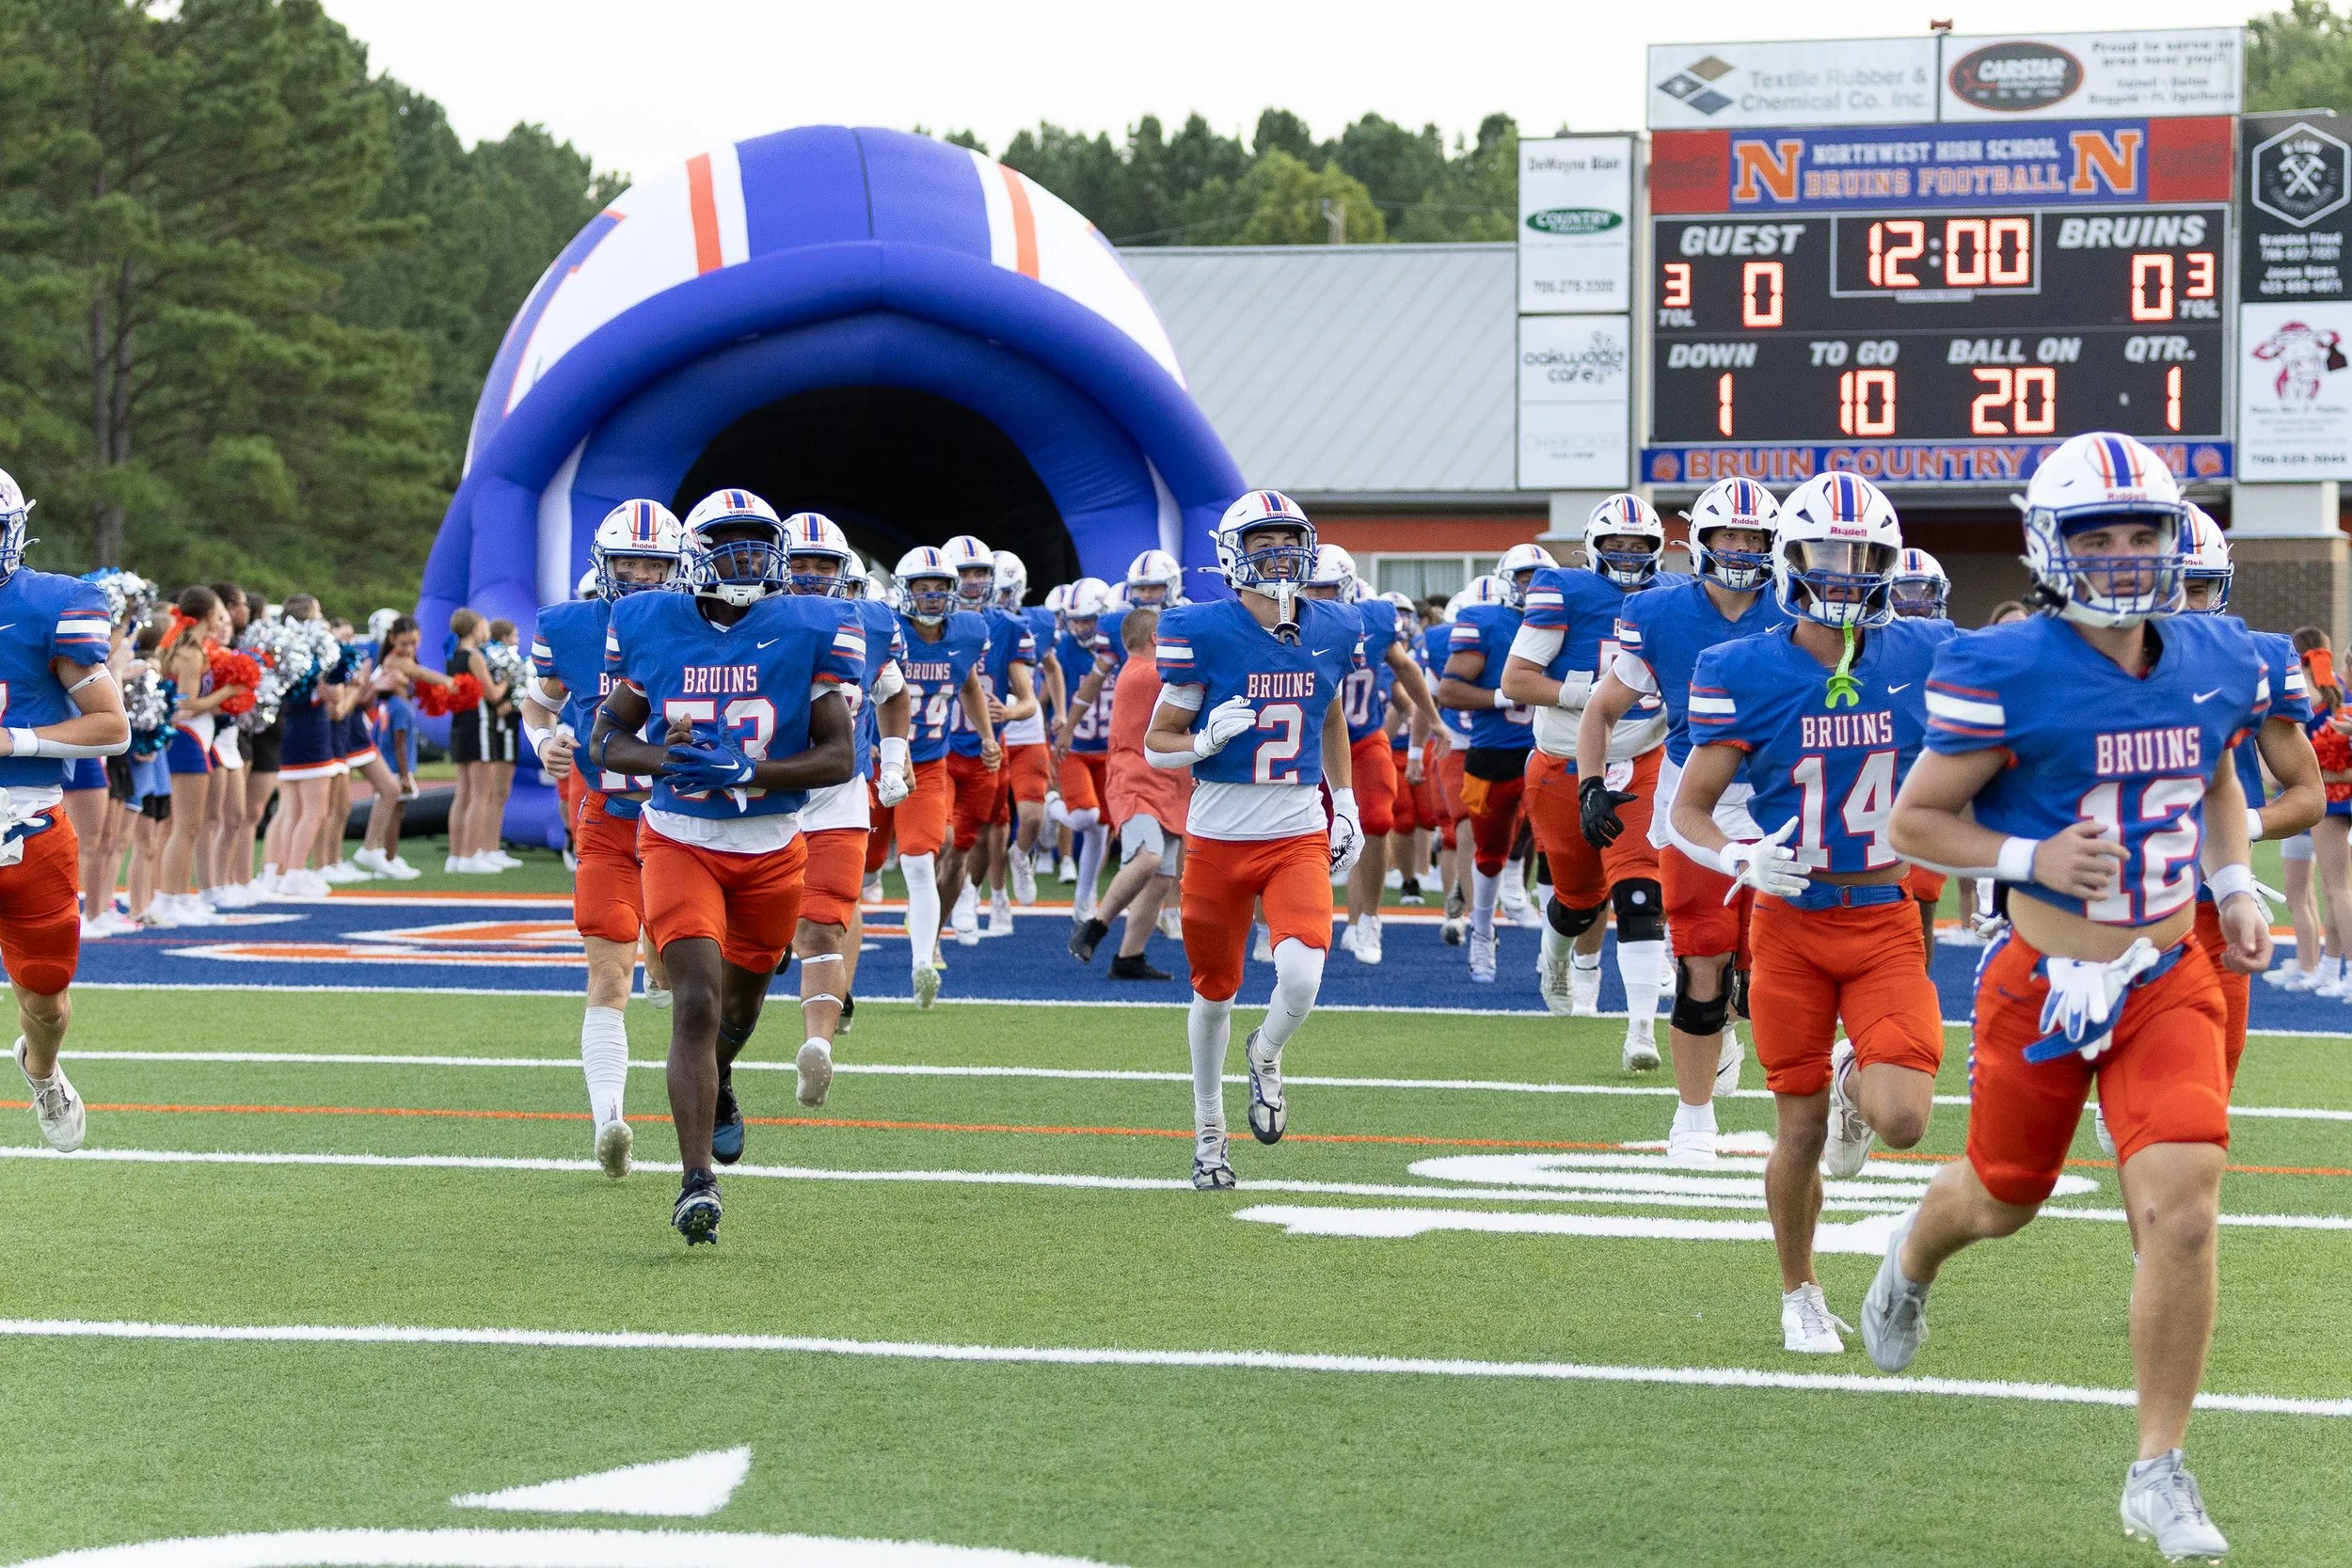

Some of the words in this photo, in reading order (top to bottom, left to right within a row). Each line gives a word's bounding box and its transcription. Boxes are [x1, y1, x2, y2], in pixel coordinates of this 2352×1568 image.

[1750, 70, 1819, 88] Textile
[1826, 68, 1904, 87] Rubber
[1912, 67, 1926, 84] &
[1741, 92, 1839, 112] Chemical
[1848, 91, 1881, 109] Co.
[1891, 91, 1929, 109] Inc.
[1812, 142, 1932, 165] NORTHWEST
[1935, 139, 1983, 162] HIGH
[1986, 137, 2061, 161] SCHOOL
[2069, 129, 2144, 196] N
[1733, 139, 1804, 203] N
[1804, 168, 1911, 200] BRUINS
[1916, 164, 2066, 198] FOOTBALL
[1679, 224, 1807, 257] GUEST
[2057, 214, 2207, 249] BRUINS
[1868, 217, 2030, 288] 12:00
[1663, 262, 1692, 308] 3
[2131, 254, 2174, 322] 0
[2185, 252, 2215, 297] 3
[1742, 261, 1784, 328] 0
[2178, 299, 2220, 319] TOL
[1658, 308, 1697, 327] TOL
[1667, 341, 1759, 369] DOWN
[1808, 341, 1850, 368] TO
[1855, 340, 1900, 367] GO
[1947, 338, 2027, 365] BALL
[2036, 337, 2083, 364] ON
[2124, 335, 2197, 364] QTR.
[1718, 372, 1734, 436] 1
[1839, 369, 1897, 436] 10
[1971, 366, 2057, 435] 20
[2166, 366, 2182, 433] 1
[1684, 448, 1816, 481] BRUIN
[1823, 441, 2029, 482] COUNTRY
[2107, 492, 2148, 501] Riddell
[1731, 517, 1759, 527] Riddell
[1830, 526, 1867, 537] Riddell
[682, 664, 758, 694] BRUINS
[905, 661, 951, 680] BRUINS
[1248, 672, 1315, 699] BRUINS
[1252, 701, 1305, 784] 2
[1801, 710, 1893, 749] BRUINS
[2094, 725, 2201, 777] BRUINS
[1790, 747, 1899, 873] 14
[2075, 774, 2207, 927] 12
